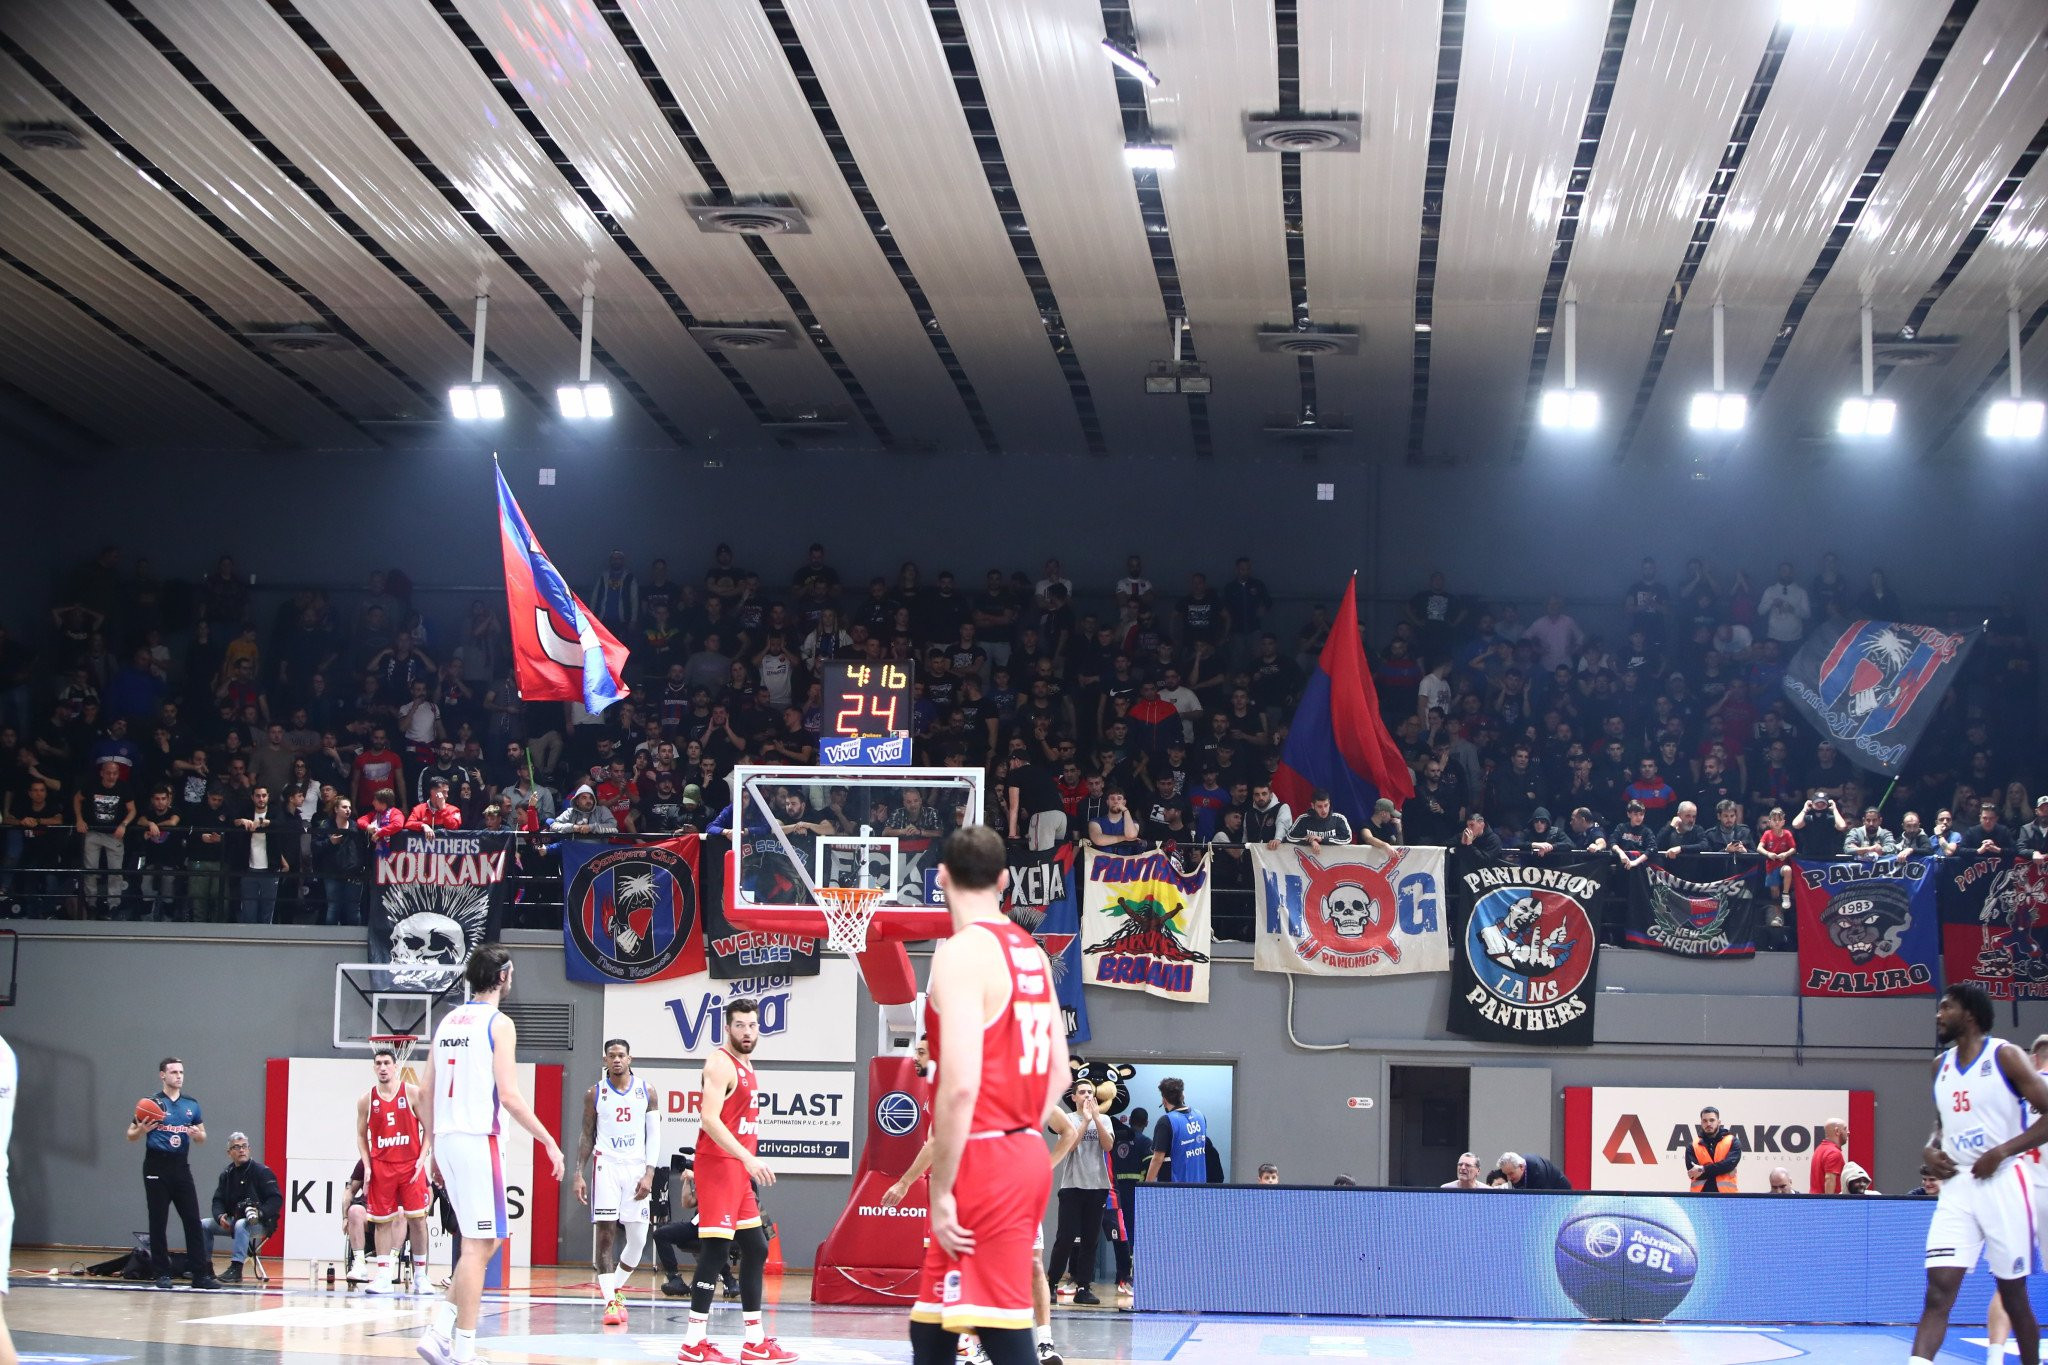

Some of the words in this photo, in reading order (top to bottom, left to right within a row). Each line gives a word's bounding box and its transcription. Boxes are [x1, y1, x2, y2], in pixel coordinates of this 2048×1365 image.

[847, 664, 907, 688] 4:16
[836, 694, 896, 732] 24
[825, 746, 859, 763] Viva
[867, 746, 901, 763] Viva
[407, 837, 480, 854] PANTHERS
[588, 850, 647, 874] Panthers
[651, 850, 677, 865] Club
[1464, 866, 1601, 899] PANIONIOS
[1646, 866, 1745, 896] PANTHERS
[1841, 901, 1871, 914] 1983
[712, 930, 815, 958] WORKING
[1647, 925, 1730, 953] GENERATION
[1675, 927, 1701, 938] NEW
[629, 953, 671, 977] Kosmos
[738, 946, 791, 965] CLASS
[1322, 951, 1380, 969] PANIONIOS
[1494, 974, 1559, 1002] LANS
[1806, 963, 1931, 993] FALIRO
[1465, 984, 1587, 1031] PANTHERS
[665, 992, 790, 1050] Via
[1952, 1090, 1971, 1112] 35
[386, 1112, 396, 1126] 5
[615, 1106, 632, 1122] 25
[1186, 1121, 1200, 1135] 056
[1666, 1124, 1827, 1153] AAKO
[377, 1132, 410, 1149] bwin
[758, 1143, 838, 1156] drivaplast.gr
[1626, 1242, 1674, 1273] GBL
